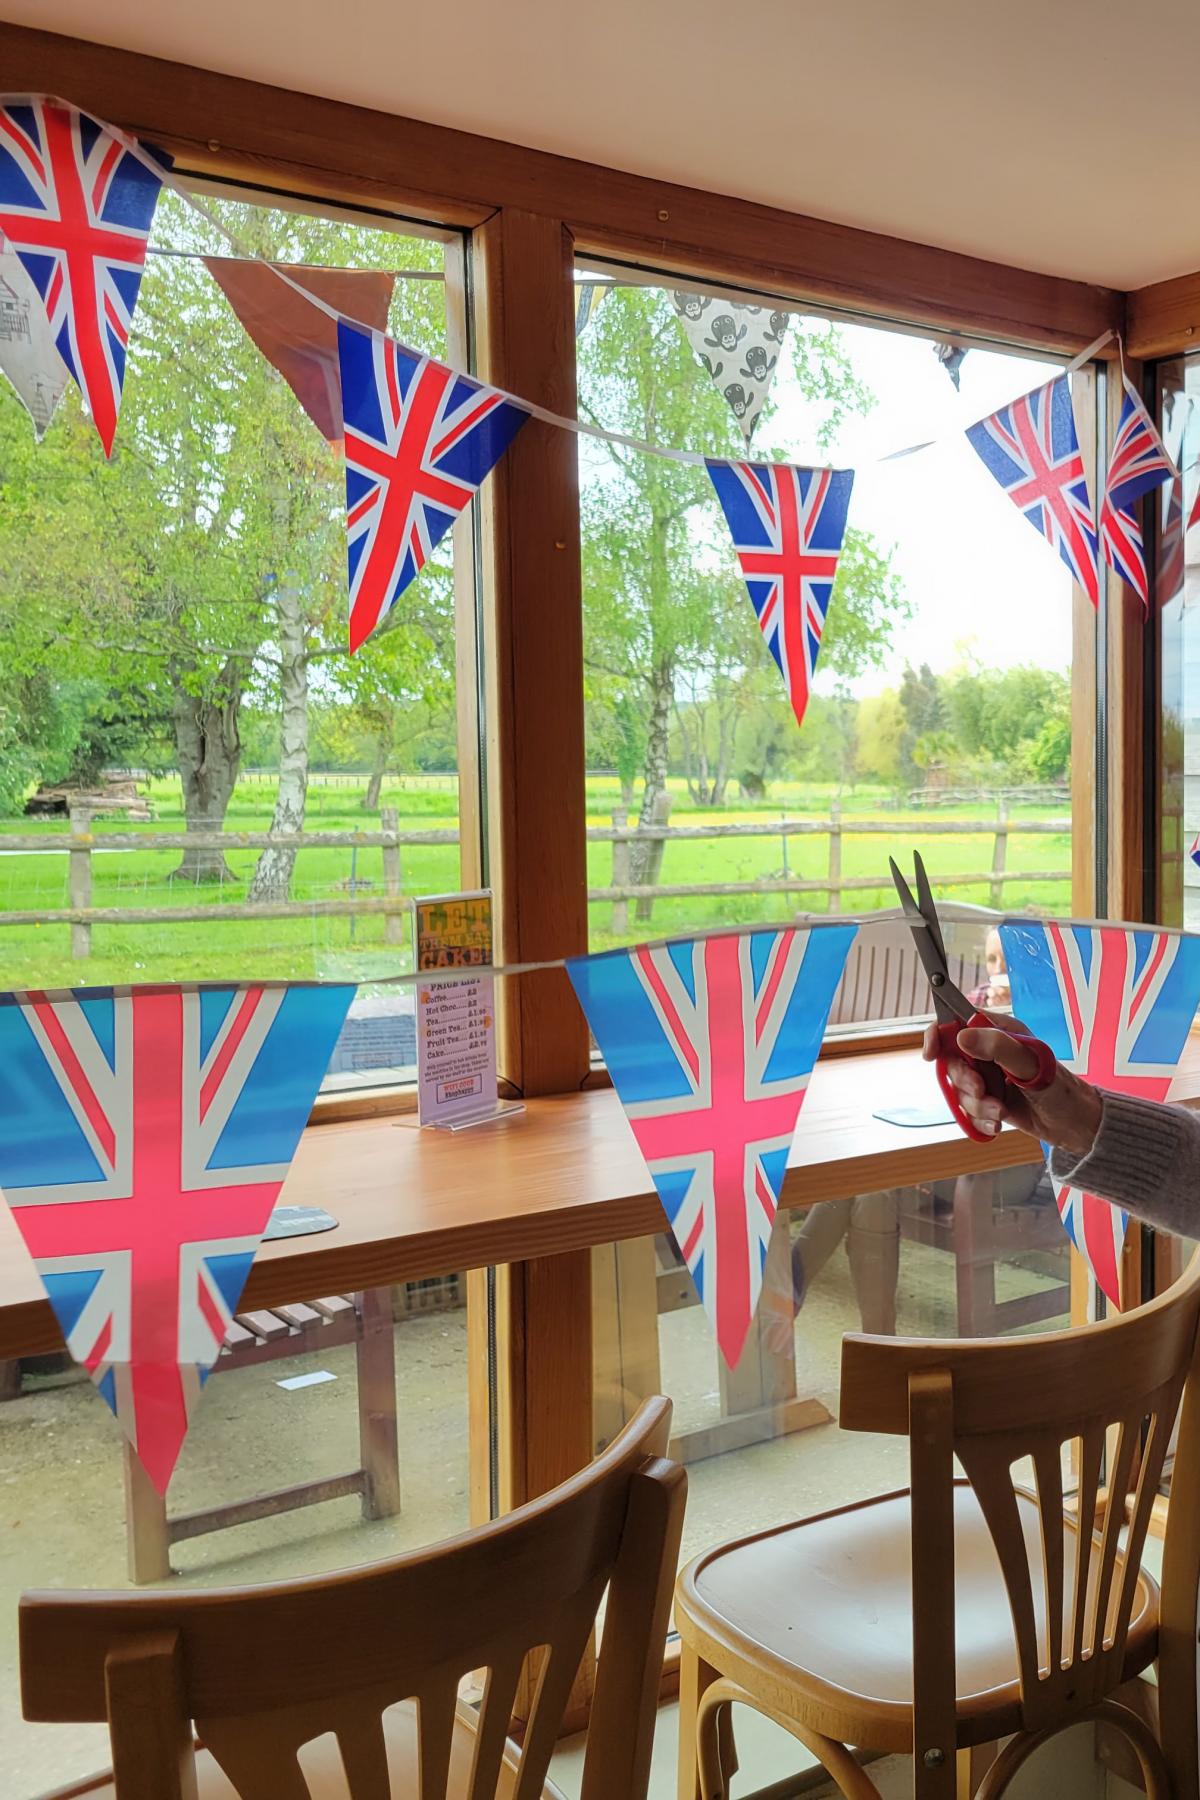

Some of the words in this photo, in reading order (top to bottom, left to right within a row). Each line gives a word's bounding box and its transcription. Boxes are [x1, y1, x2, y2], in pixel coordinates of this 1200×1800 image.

[418, 900, 490, 938] LET
[419, 935, 462, 952] THEM
[466, 930, 490, 946] EAT
[420, 943, 492, 970] CAKE!
[426, 1008, 438, 1016] Hot
[426, 1028, 447, 1038] Green
[427, 1039, 445, 1049] Fruit
